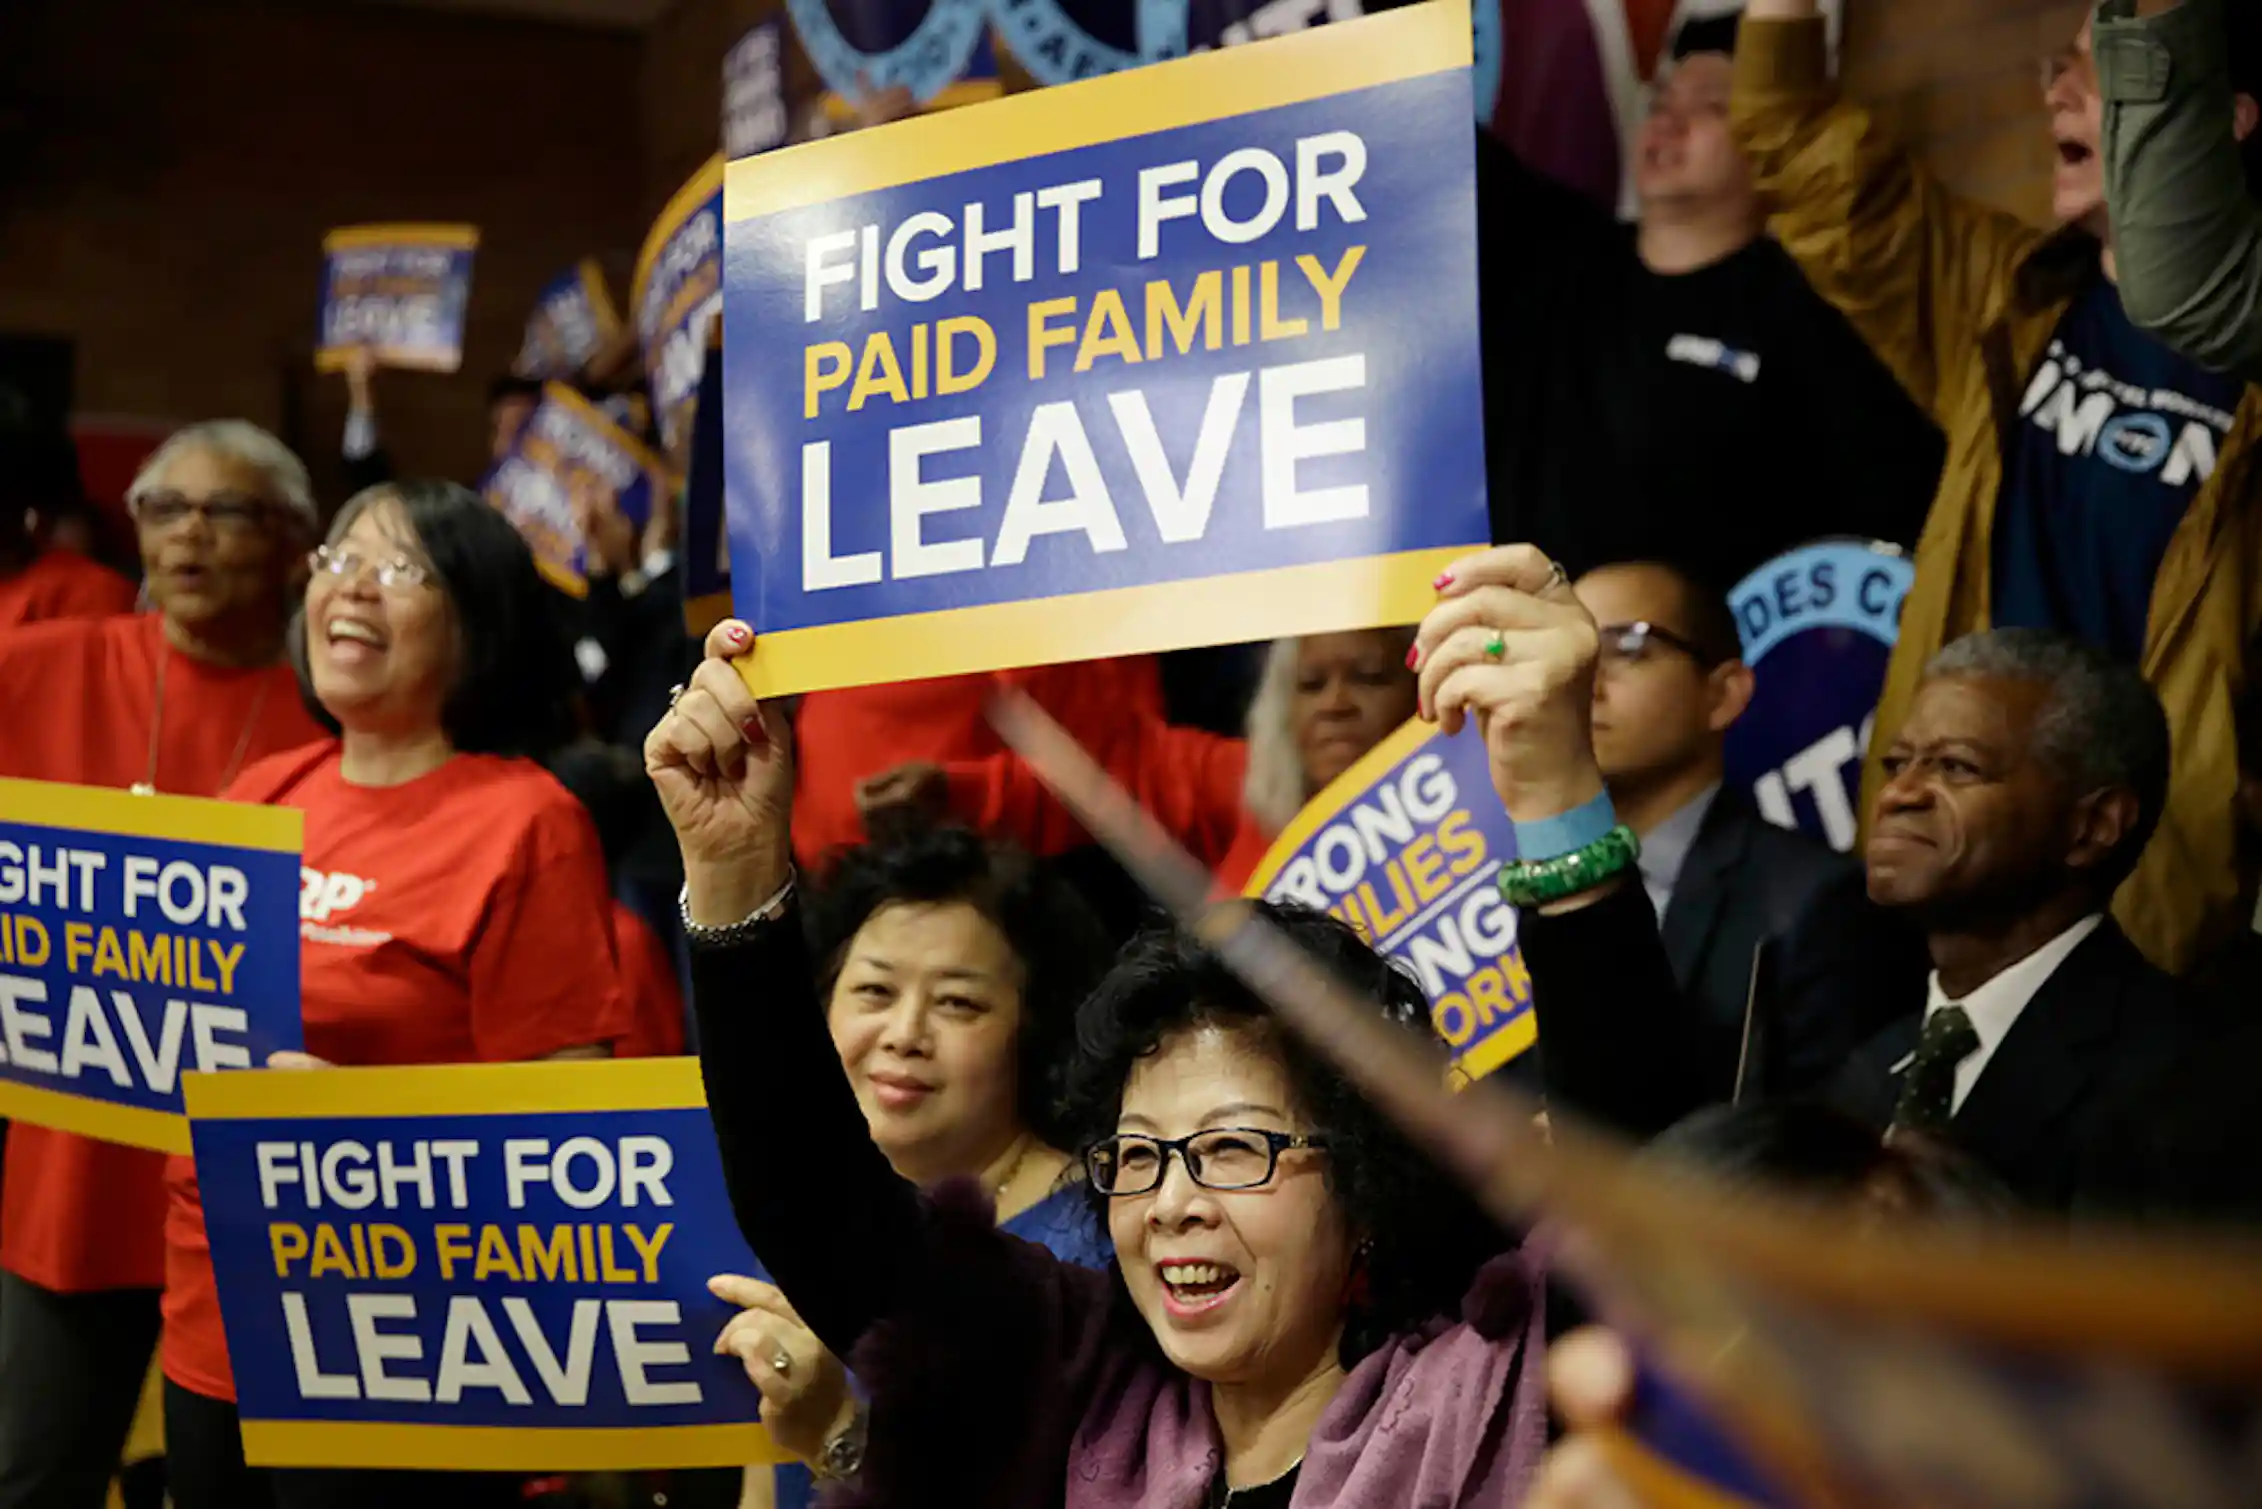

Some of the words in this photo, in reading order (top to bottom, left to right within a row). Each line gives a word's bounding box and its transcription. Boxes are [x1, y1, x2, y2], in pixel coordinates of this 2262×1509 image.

[804, 178, 1102, 323] FIGHT
[1137, 130, 1368, 260] FOR
[803, 314, 997, 419] PAID
[1027, 245, 1368, 380] FAMILY
[801, 353, 1370, 592] LEAVE
[0, 840, 107, 913] GHT
[123, 854, 249, 931] FOR
[0, 912, 51, 967] ID
[64, 920, 246, 994] FAMILY
[256, 1139, 480, 1209] FIGHT
[504, 1136, 674, 1208] FOR
[268, 1222, 417, 1279] PAID
[433, 1223, 675, 1283] FAMILY
[281, 1291, 703, 1406] LEAVE
